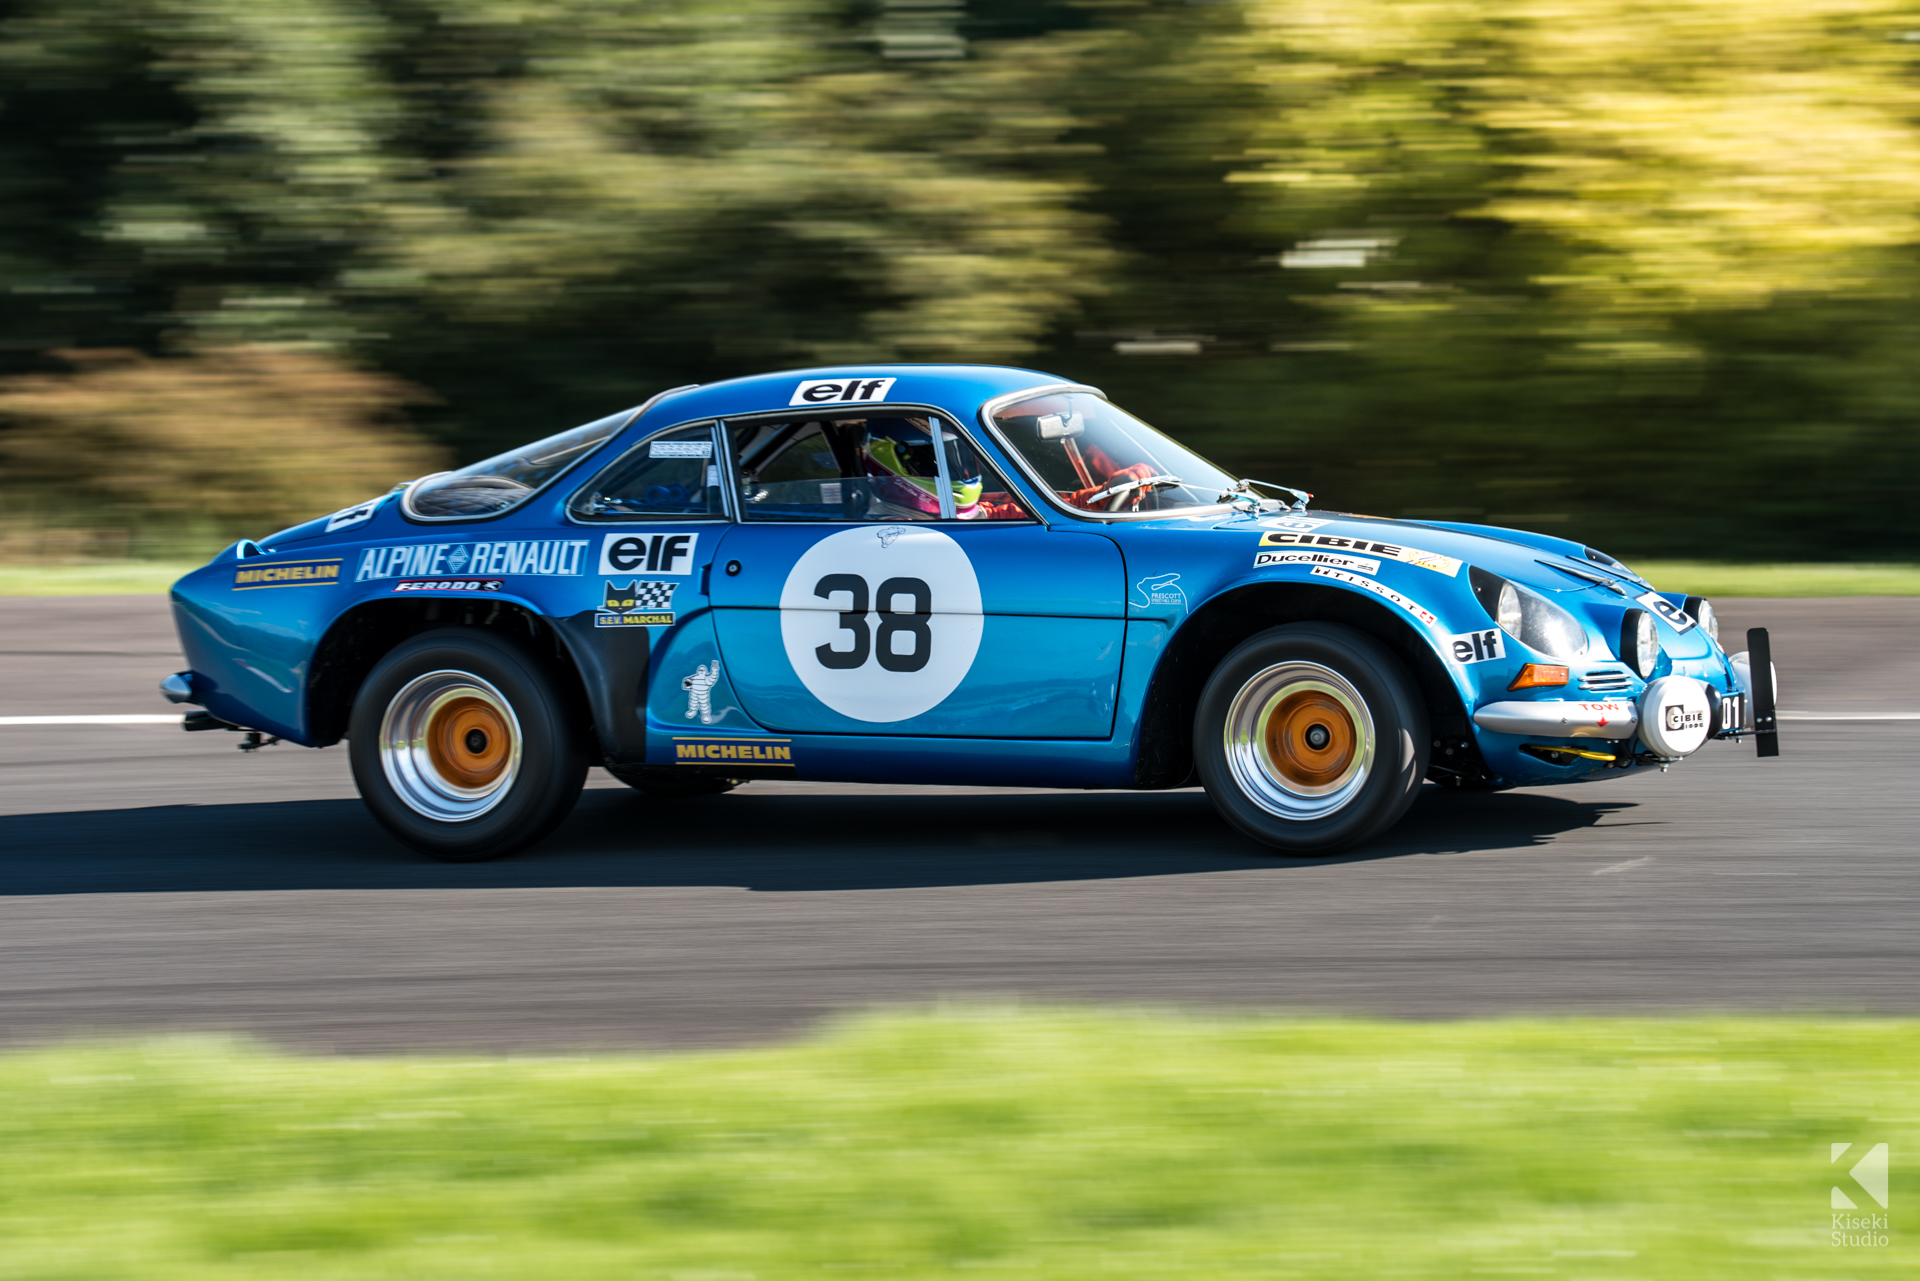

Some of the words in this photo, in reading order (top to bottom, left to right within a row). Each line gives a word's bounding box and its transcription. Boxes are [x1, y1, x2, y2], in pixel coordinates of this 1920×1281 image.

[803, 379, 886, 402] elf
[608, 535, 691, 571] elf
[1267, 533, 1402, 557] CIBIE
[355, 544, 451, 581] ALPINE
[468, 541, 590, 575] RENAULT
[1257, 554, 1355, 566] Ducellier
[235, 565, 340, 584] MICHELIN
[395, 581, 481, 591] FERODO
[1334, 571, 1418, 611] TISSOT
[623, 615, 673, 624] MARCHAL
[813, 573, 932, 673] 38
[1452, 630, 1497, 663] elf
[1578, 703, 1619, 711] TOW
[676, 744, 791, 760] MICHELIN
